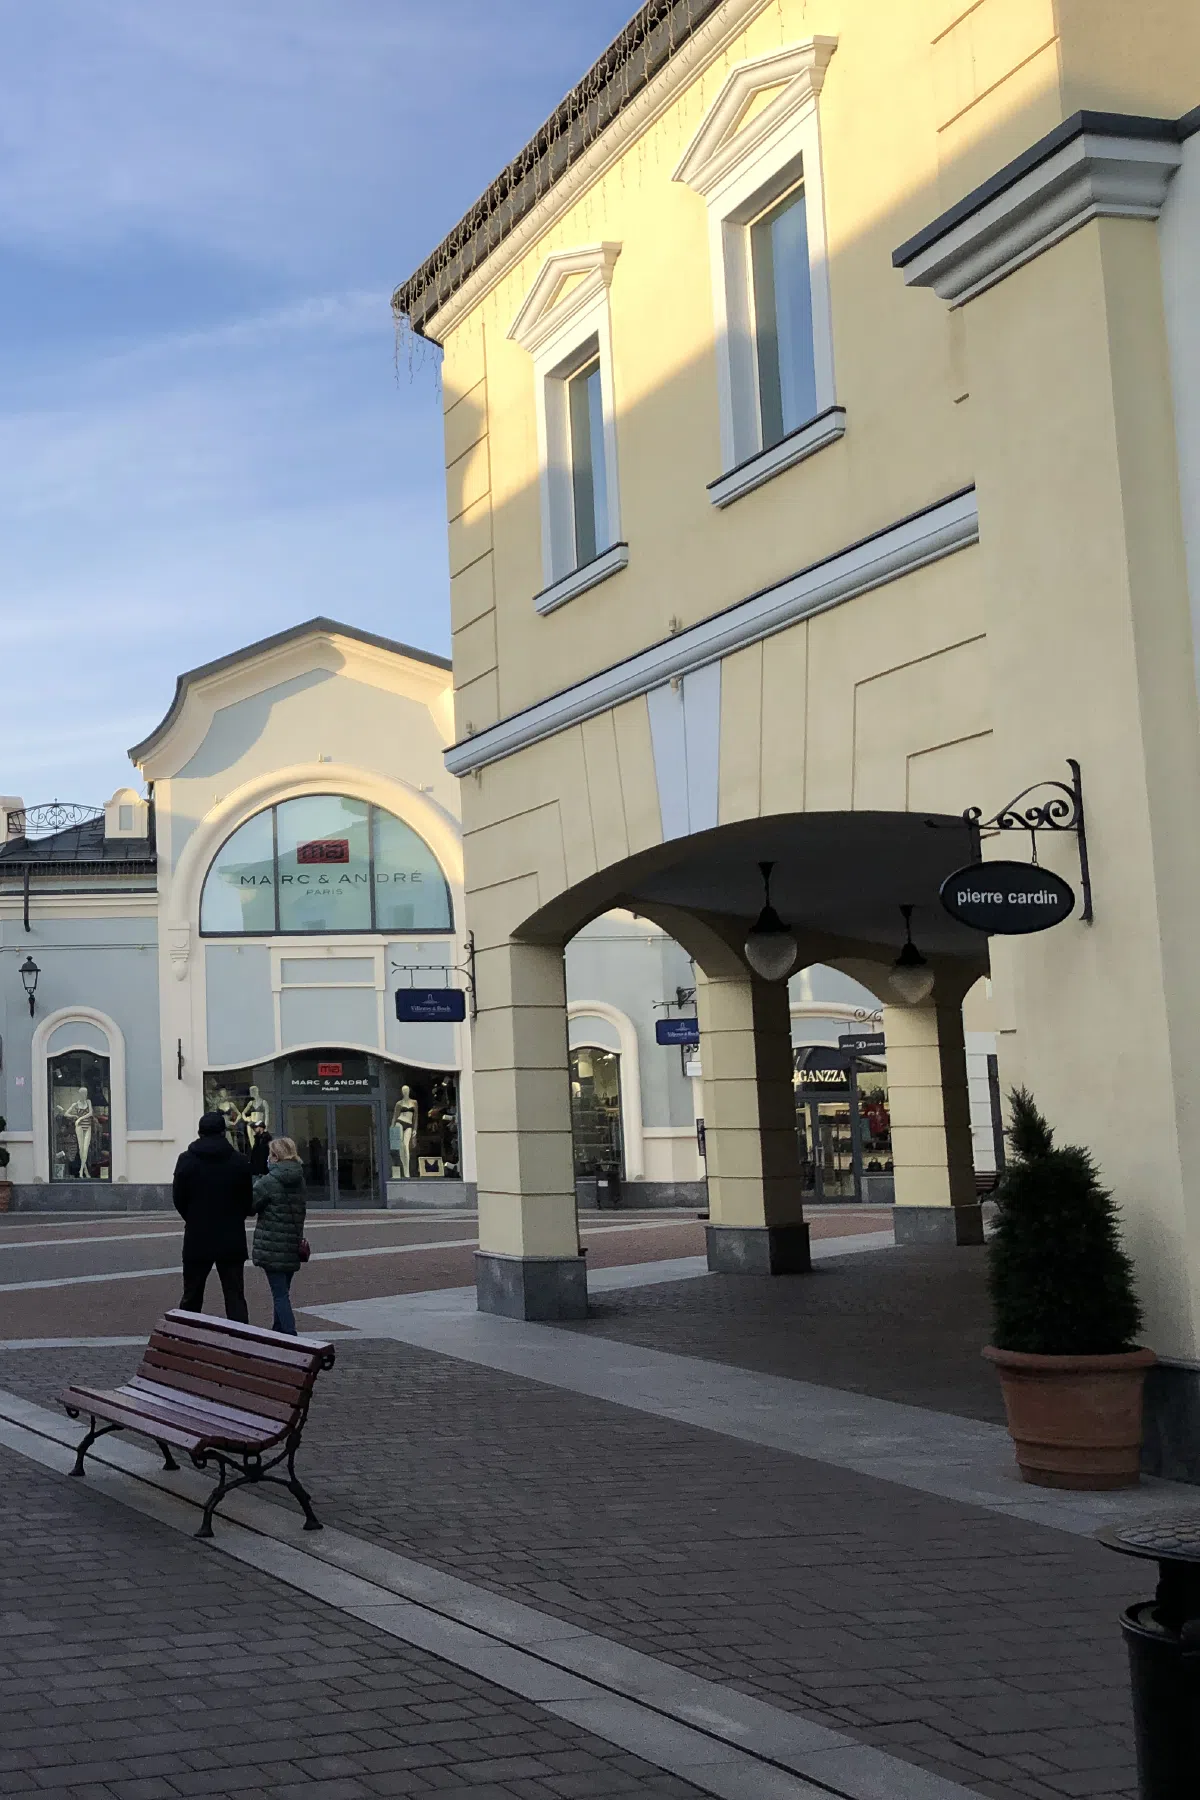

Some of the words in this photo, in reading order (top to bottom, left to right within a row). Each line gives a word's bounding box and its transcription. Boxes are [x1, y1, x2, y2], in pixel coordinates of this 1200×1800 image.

[240, 874, 310, 885] MARC
[319, 874, 330, 884] &
[338, 870, 422, 885] ANDRÉ
[306, 888, 343, 896] PARIS
[957, 888, 1003, 906] pierre
[1007, 890, 1058, 905] cardin
